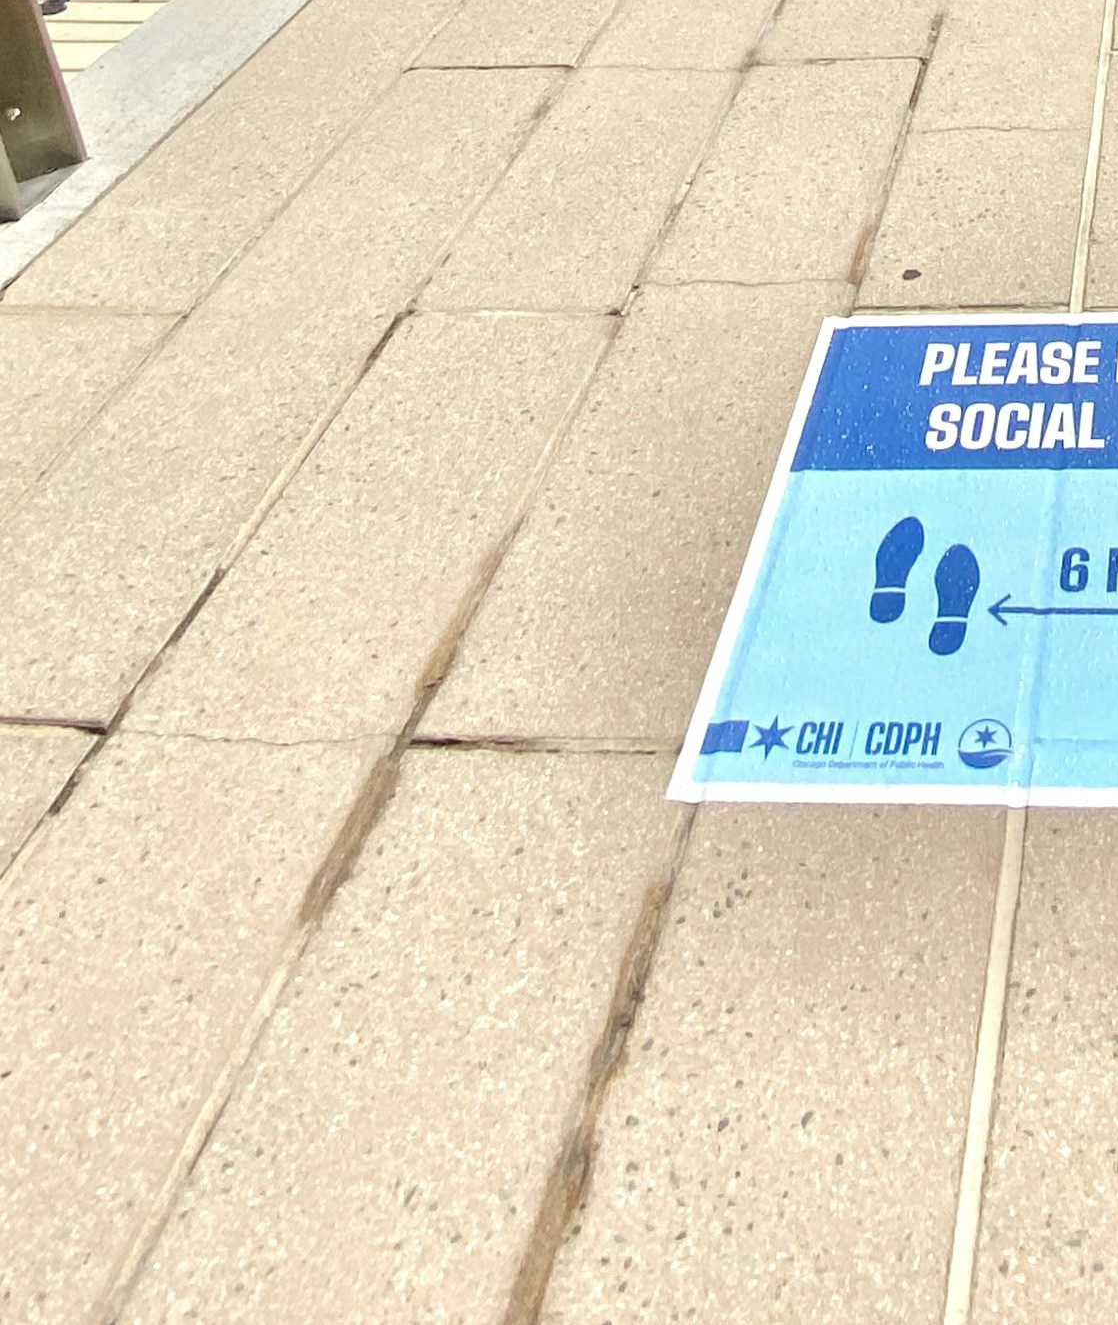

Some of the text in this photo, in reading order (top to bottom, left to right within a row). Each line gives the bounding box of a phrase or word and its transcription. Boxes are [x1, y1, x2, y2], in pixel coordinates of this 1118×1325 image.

[919, 341, 1101, 385] PLEASE
[925, 402, 1104, 450] SOCIAL
[1060, 547, 1089, 592] 6
[796, 721, 941, 756] CHI CDPH
[792, 759, 826, 769] Chicago
[828, 759, 877, 769] Department
[889, 760, 915, 769] Public
[916, 760, 944, 769] Health
